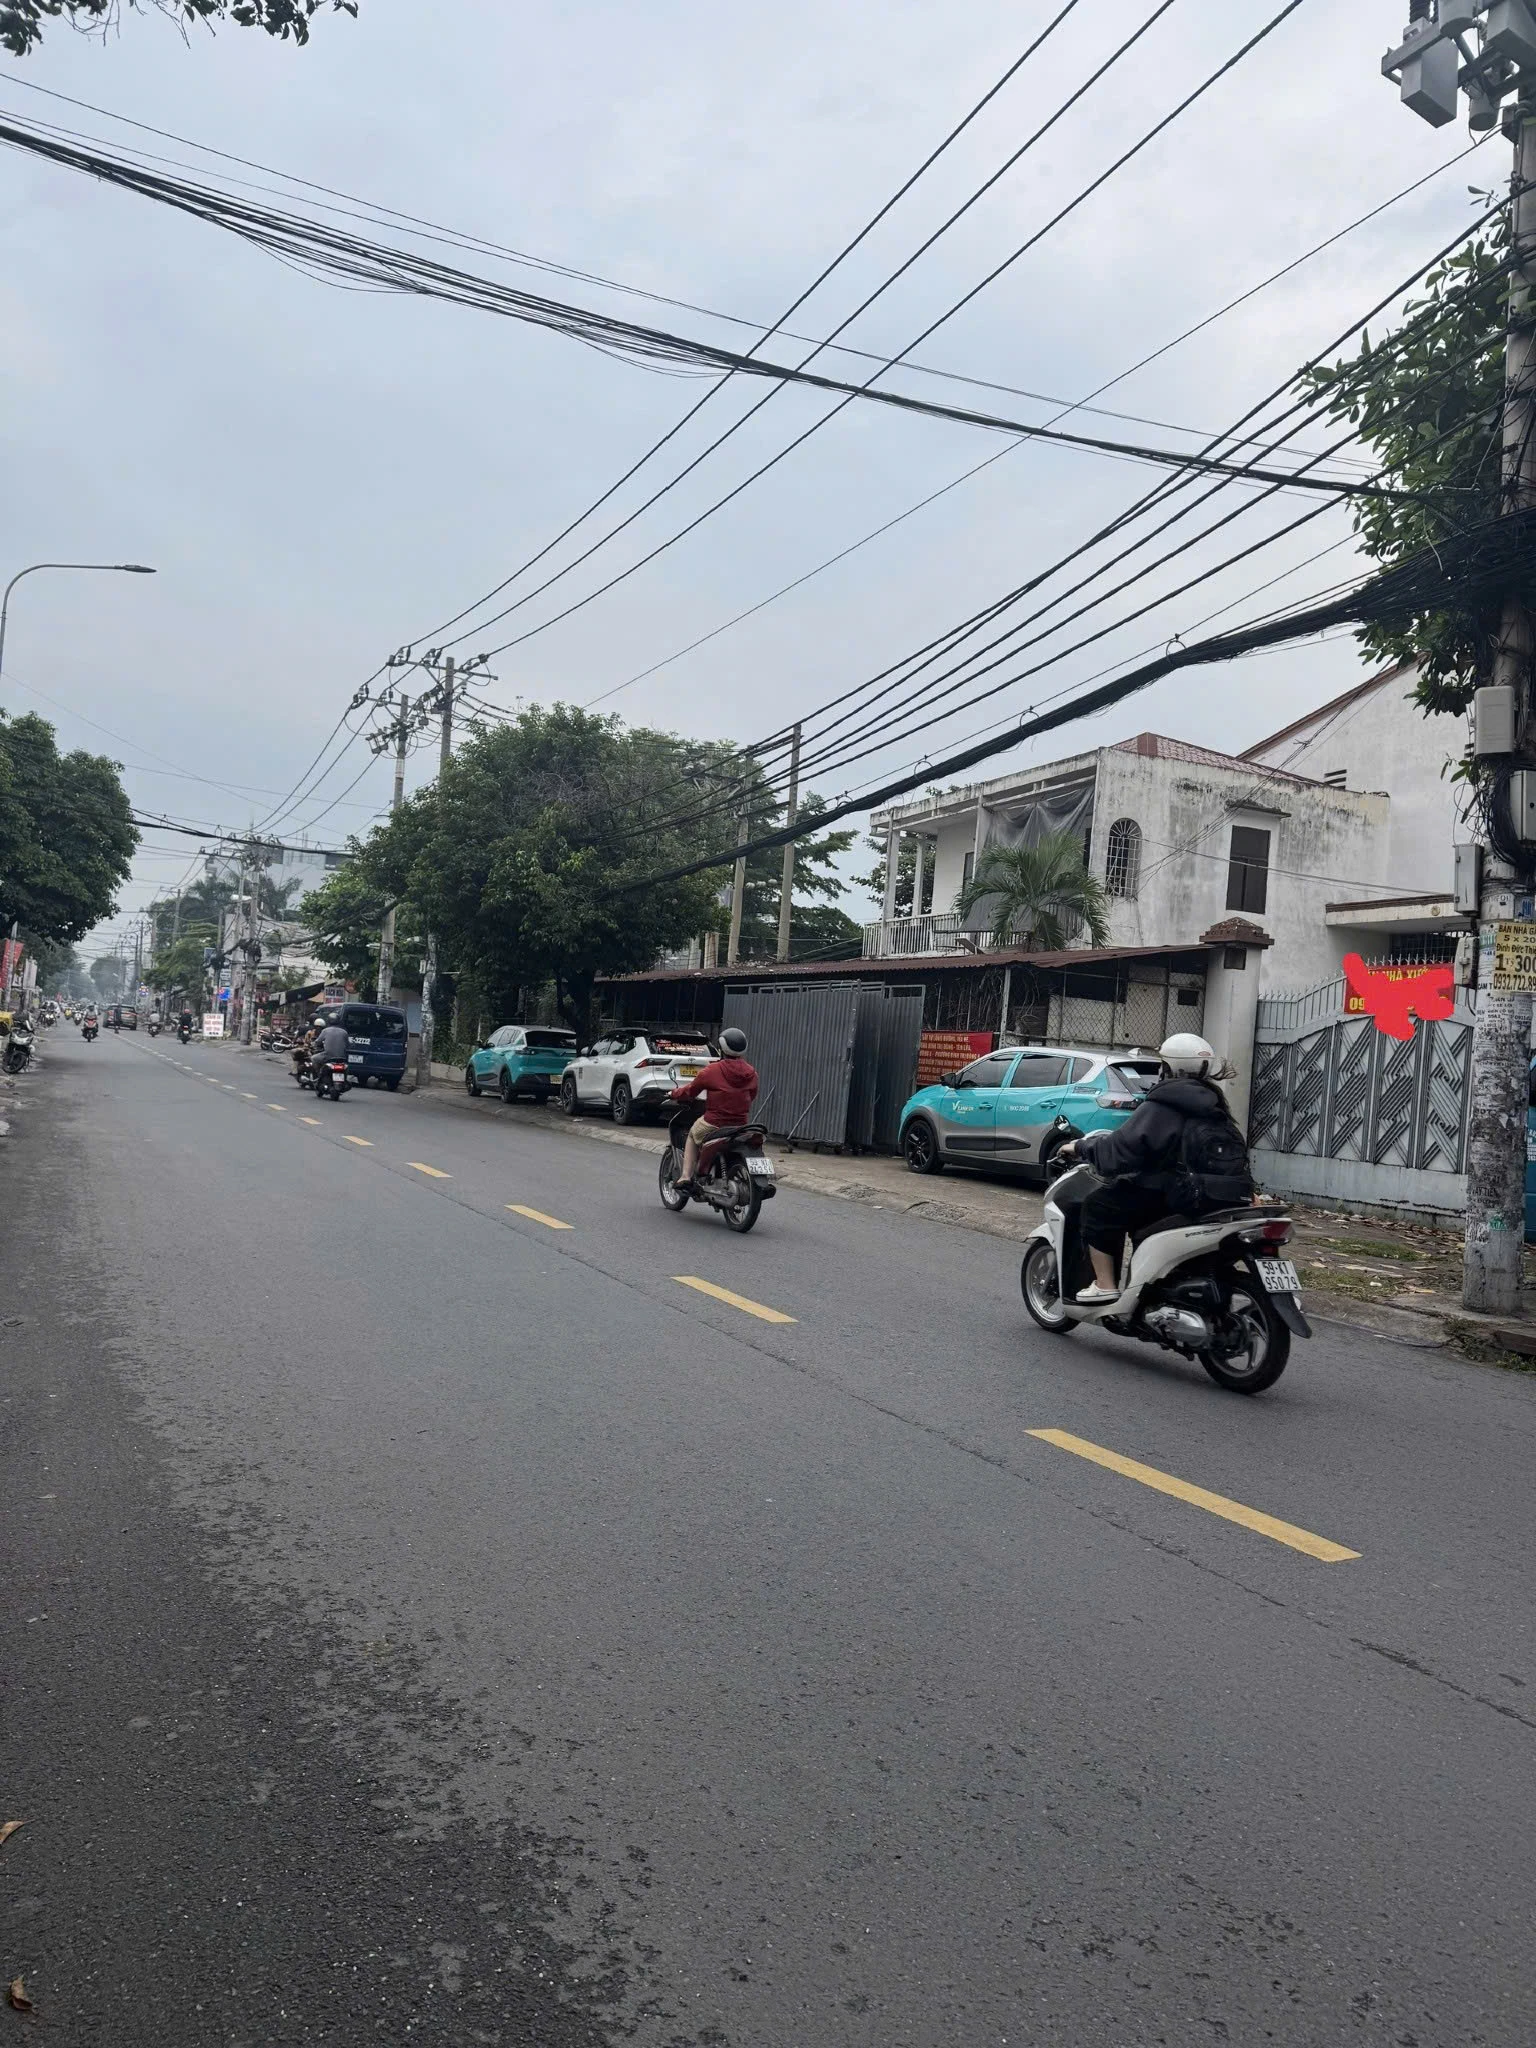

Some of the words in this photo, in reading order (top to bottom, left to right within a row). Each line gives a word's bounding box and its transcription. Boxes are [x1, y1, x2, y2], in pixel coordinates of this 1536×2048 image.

[1499, 922, 1511, 933] BÁN
[1513, 924, 1527, 935] NHÀ
[1495, 954, 1506, 971] 1
